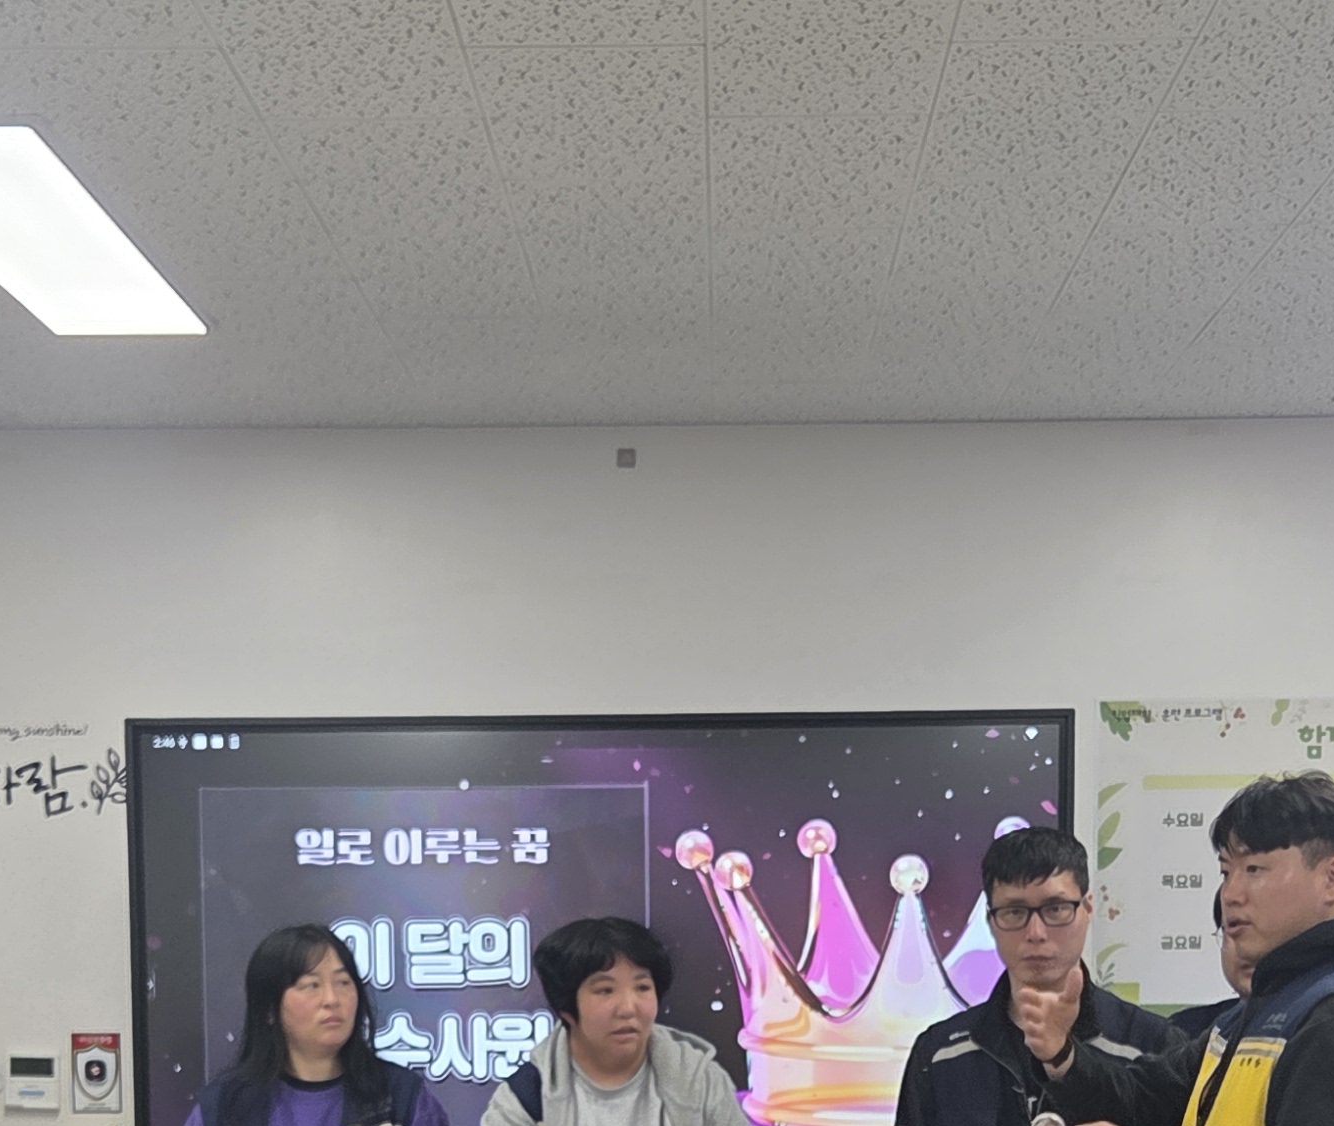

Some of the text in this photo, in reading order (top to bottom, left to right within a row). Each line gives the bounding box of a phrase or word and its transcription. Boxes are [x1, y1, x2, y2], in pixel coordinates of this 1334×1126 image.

[1183, 708, 1223, 721] 프로그램
[1162, 812, 1204, 827] 수요일
[294, 828, 551, 866] 일로 이루는 꿈
[1161, 873, 1203, 889] 목요일
[1160, 935, 1202, 950] 금요일
[329, 914, 532, 990] 이 달의
[364, 1011, 555, 1083] 수사원
